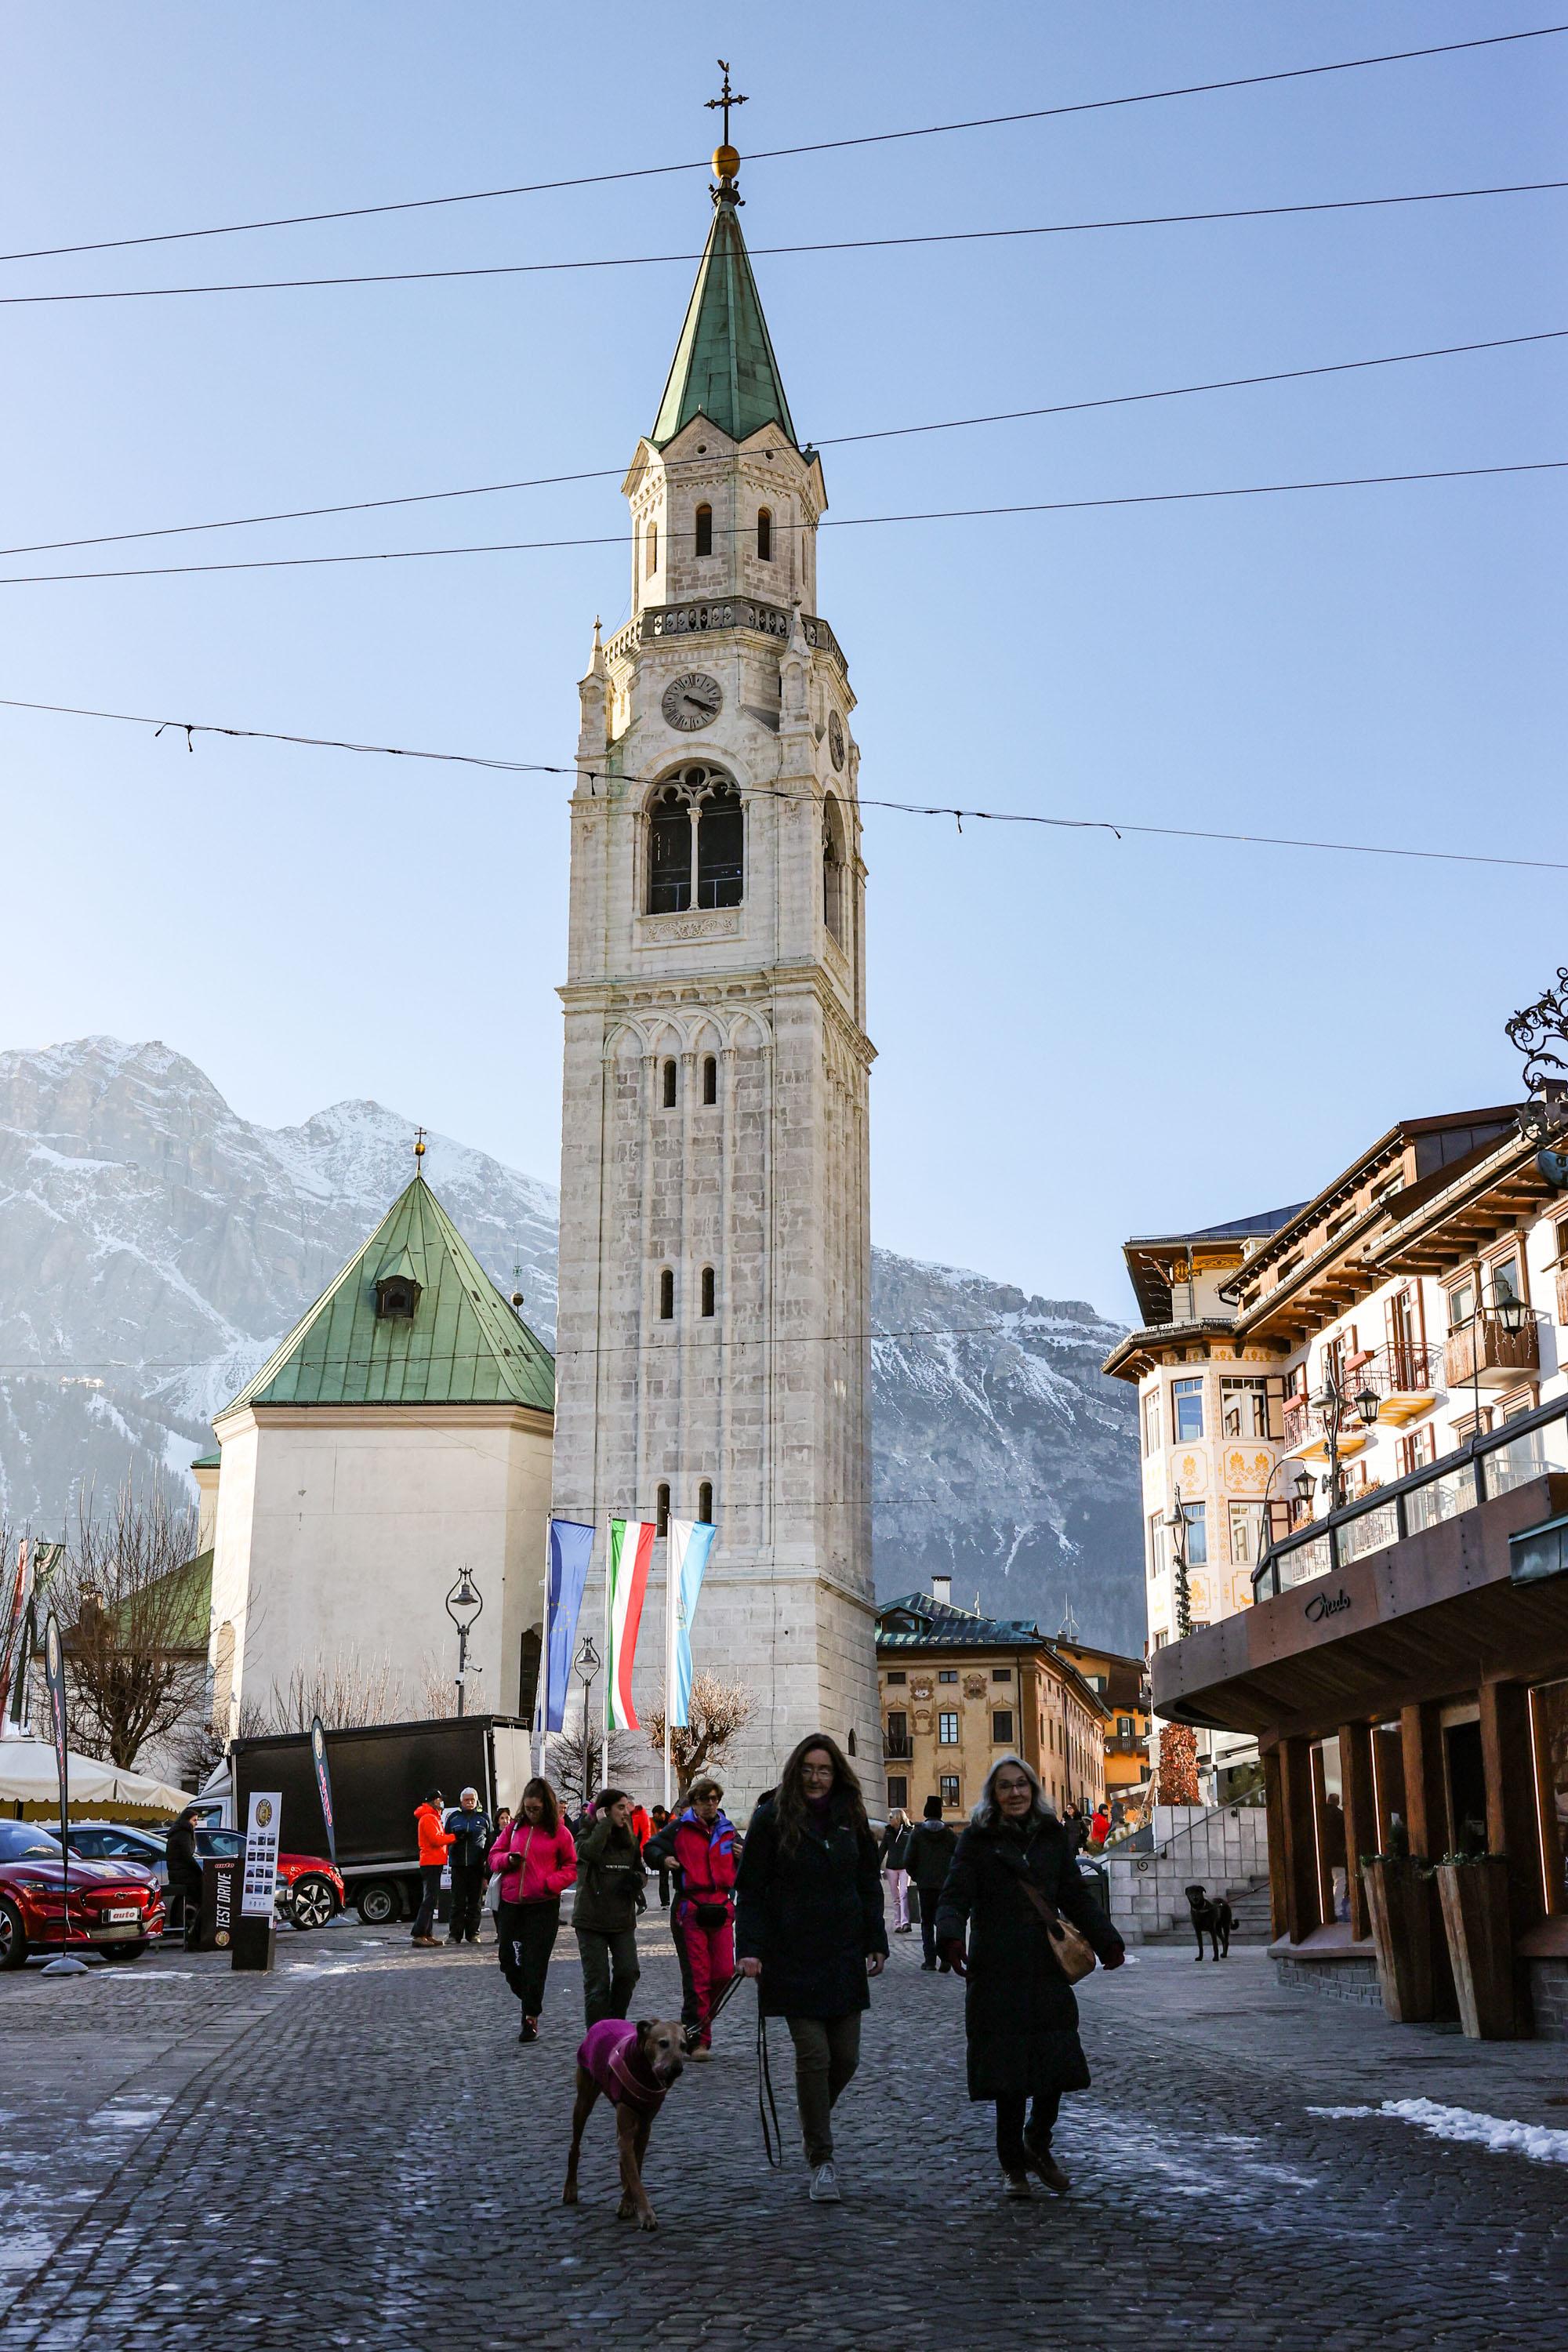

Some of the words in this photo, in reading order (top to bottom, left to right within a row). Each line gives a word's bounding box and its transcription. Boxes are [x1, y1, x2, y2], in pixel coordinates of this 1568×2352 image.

[216, 1871, 232, 1904] DRIVE
[112, 1911, 136, 1919] auto
[216, 1904, 231, 1928] TEST
